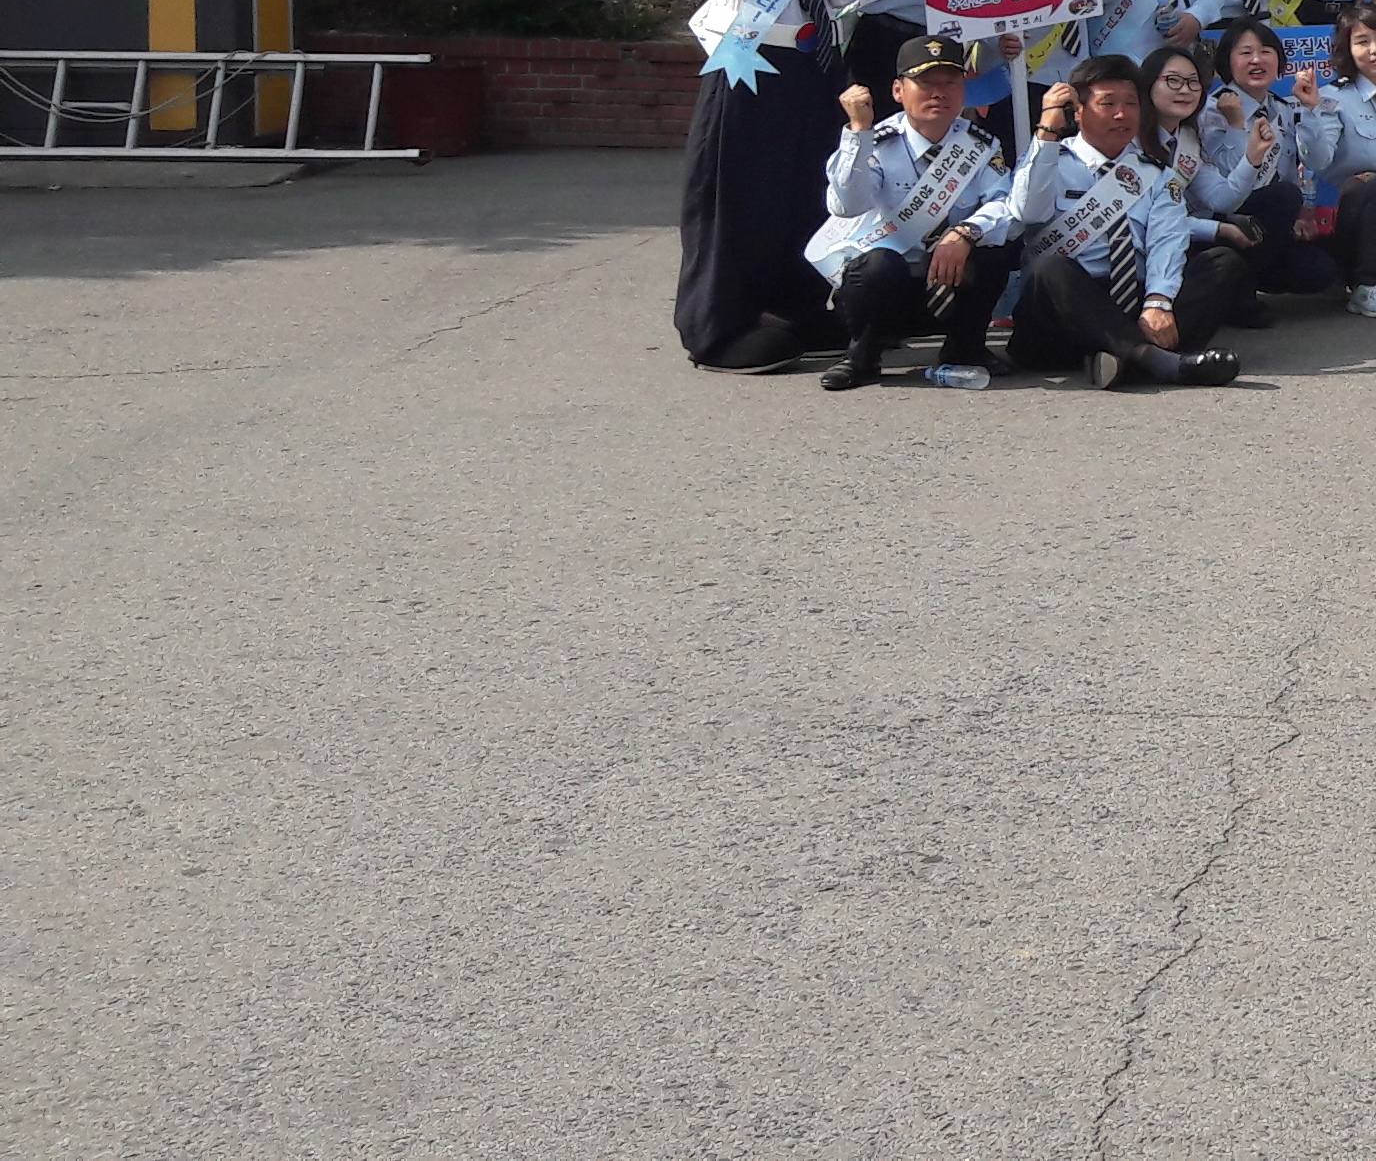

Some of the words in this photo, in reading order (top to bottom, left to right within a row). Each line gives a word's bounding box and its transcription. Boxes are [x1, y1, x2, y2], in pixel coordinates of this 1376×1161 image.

[925, 141, 968, 183] 당신의
[892, 180, 936, 224] 생명은
[1061, 194, 1101, 232] 당신의
[1087, 195, 1126, 232] 속도를
